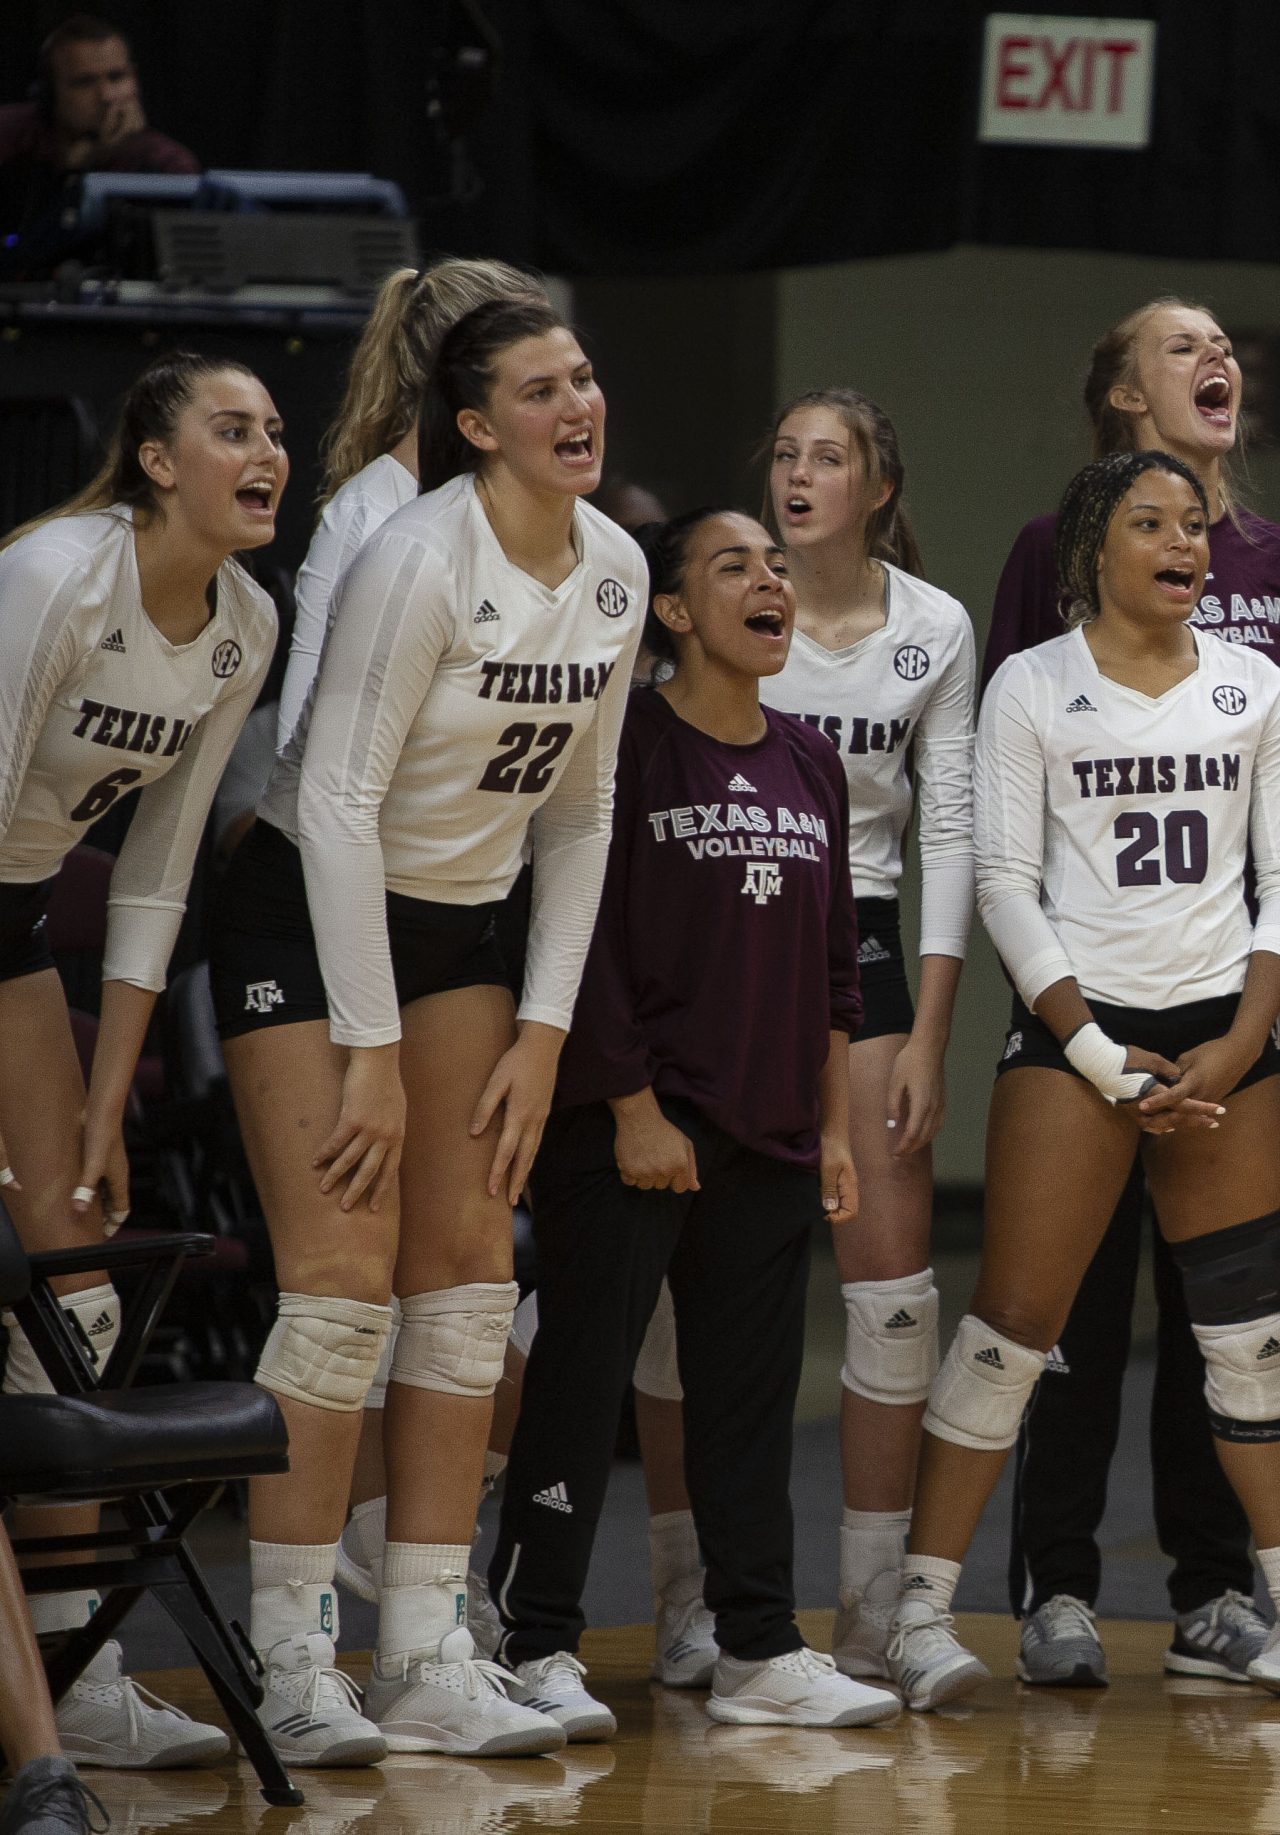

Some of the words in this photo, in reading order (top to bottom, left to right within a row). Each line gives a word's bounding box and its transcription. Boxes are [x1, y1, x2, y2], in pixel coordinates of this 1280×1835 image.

[997, 35, 1137, 114] EXIT
[597, 578, 628, 617] SEC
[477, 660, 563, 703] TEXAS
[894, 645, 930, 681] SEC
[1066, 704, 1098, 713] adidas
[1212, 685, 1247, 715] SEC
[72, 698, 166, 753] TEXAS
[476, 722, 573, 794] 22
[1072, 755, 1176, 798] TEXAS
[1184, 753, 1240, 792] A&M
[71, 767, 142, 821] 6
[648, 803, 771, 842] TEXAS
[777, 807, 829, 848] A&M
[686, 836, 820, 862] VOLLEYBALL
[1114, 809, 1208, 887] 20
[532, 1494, 573, 1513] adidas
